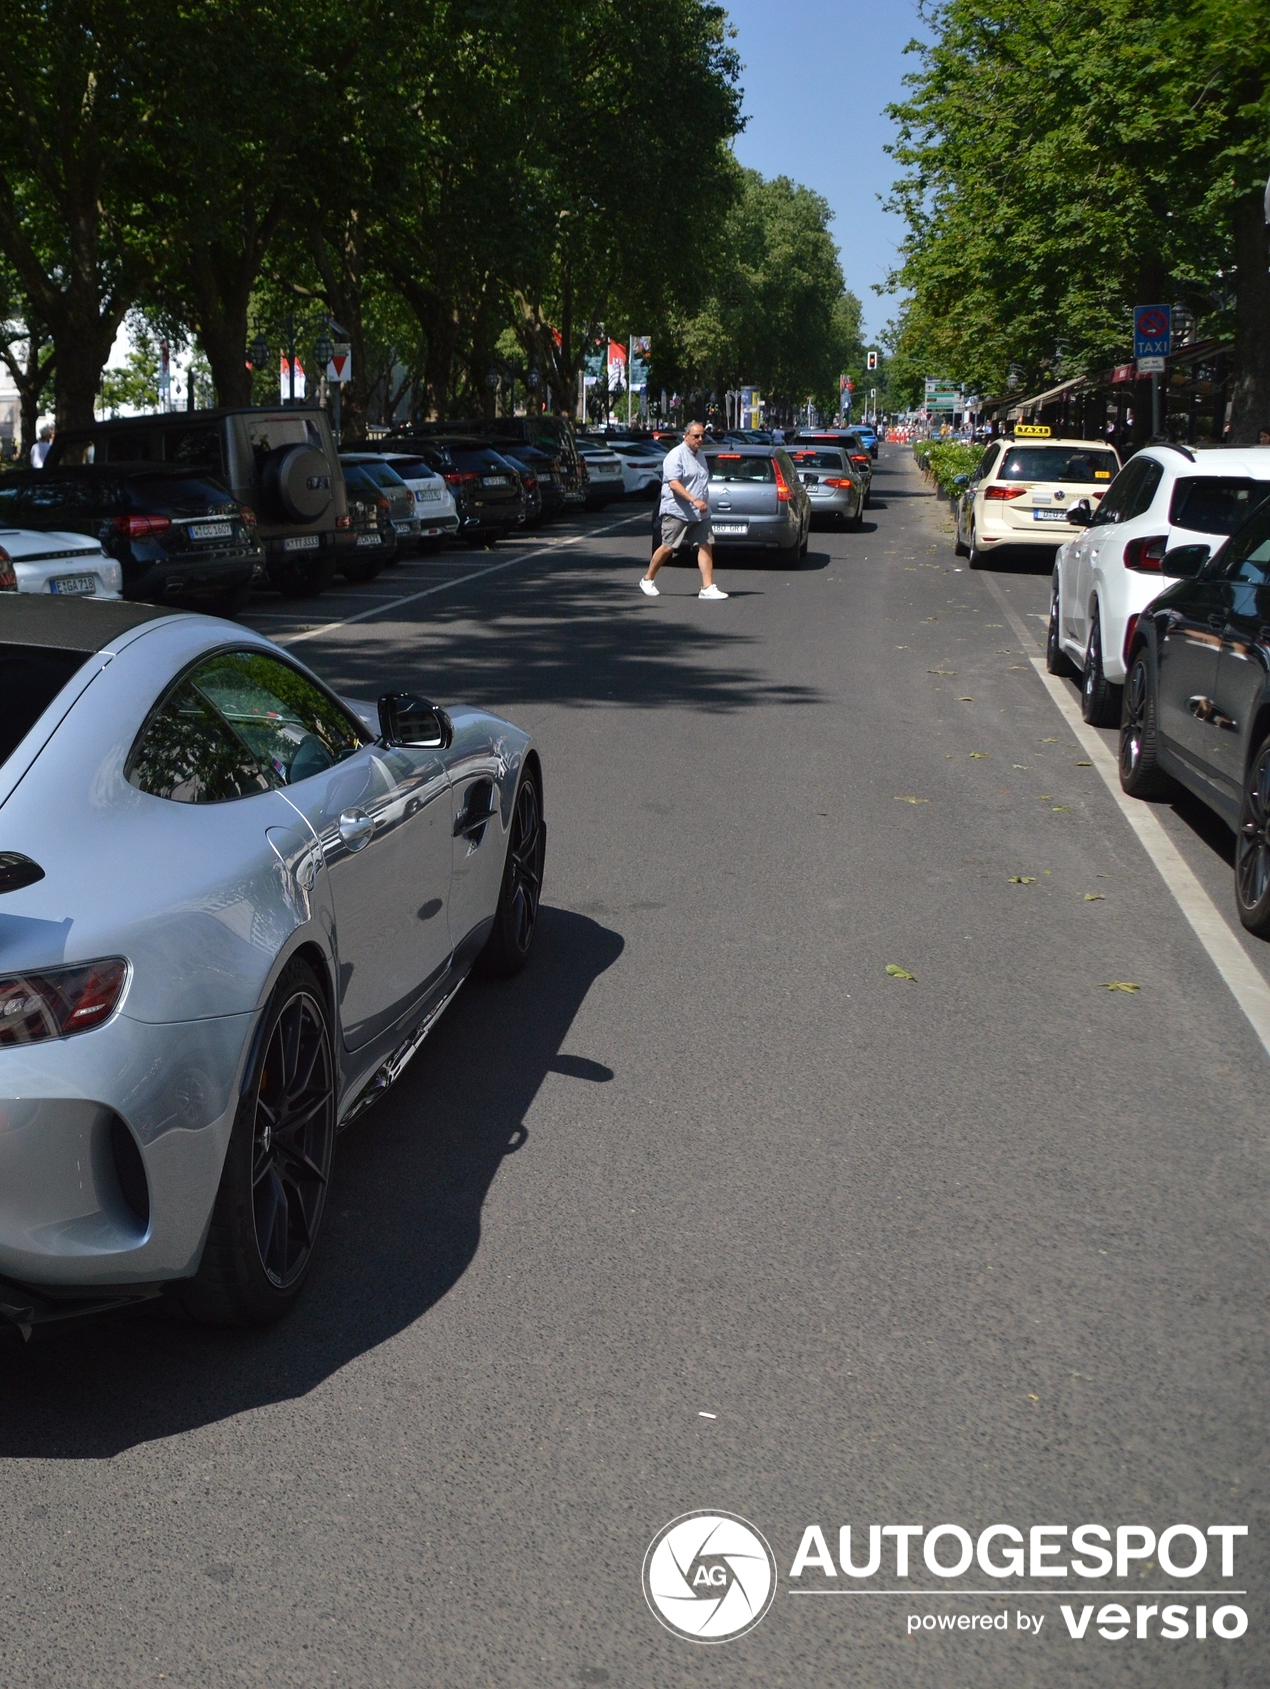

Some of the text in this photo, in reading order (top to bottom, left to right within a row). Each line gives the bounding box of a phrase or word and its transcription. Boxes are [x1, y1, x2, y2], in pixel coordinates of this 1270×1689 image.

[1137, 341, 1168, 354] TAXI
[57, 578, 94, 593] E GA 718
